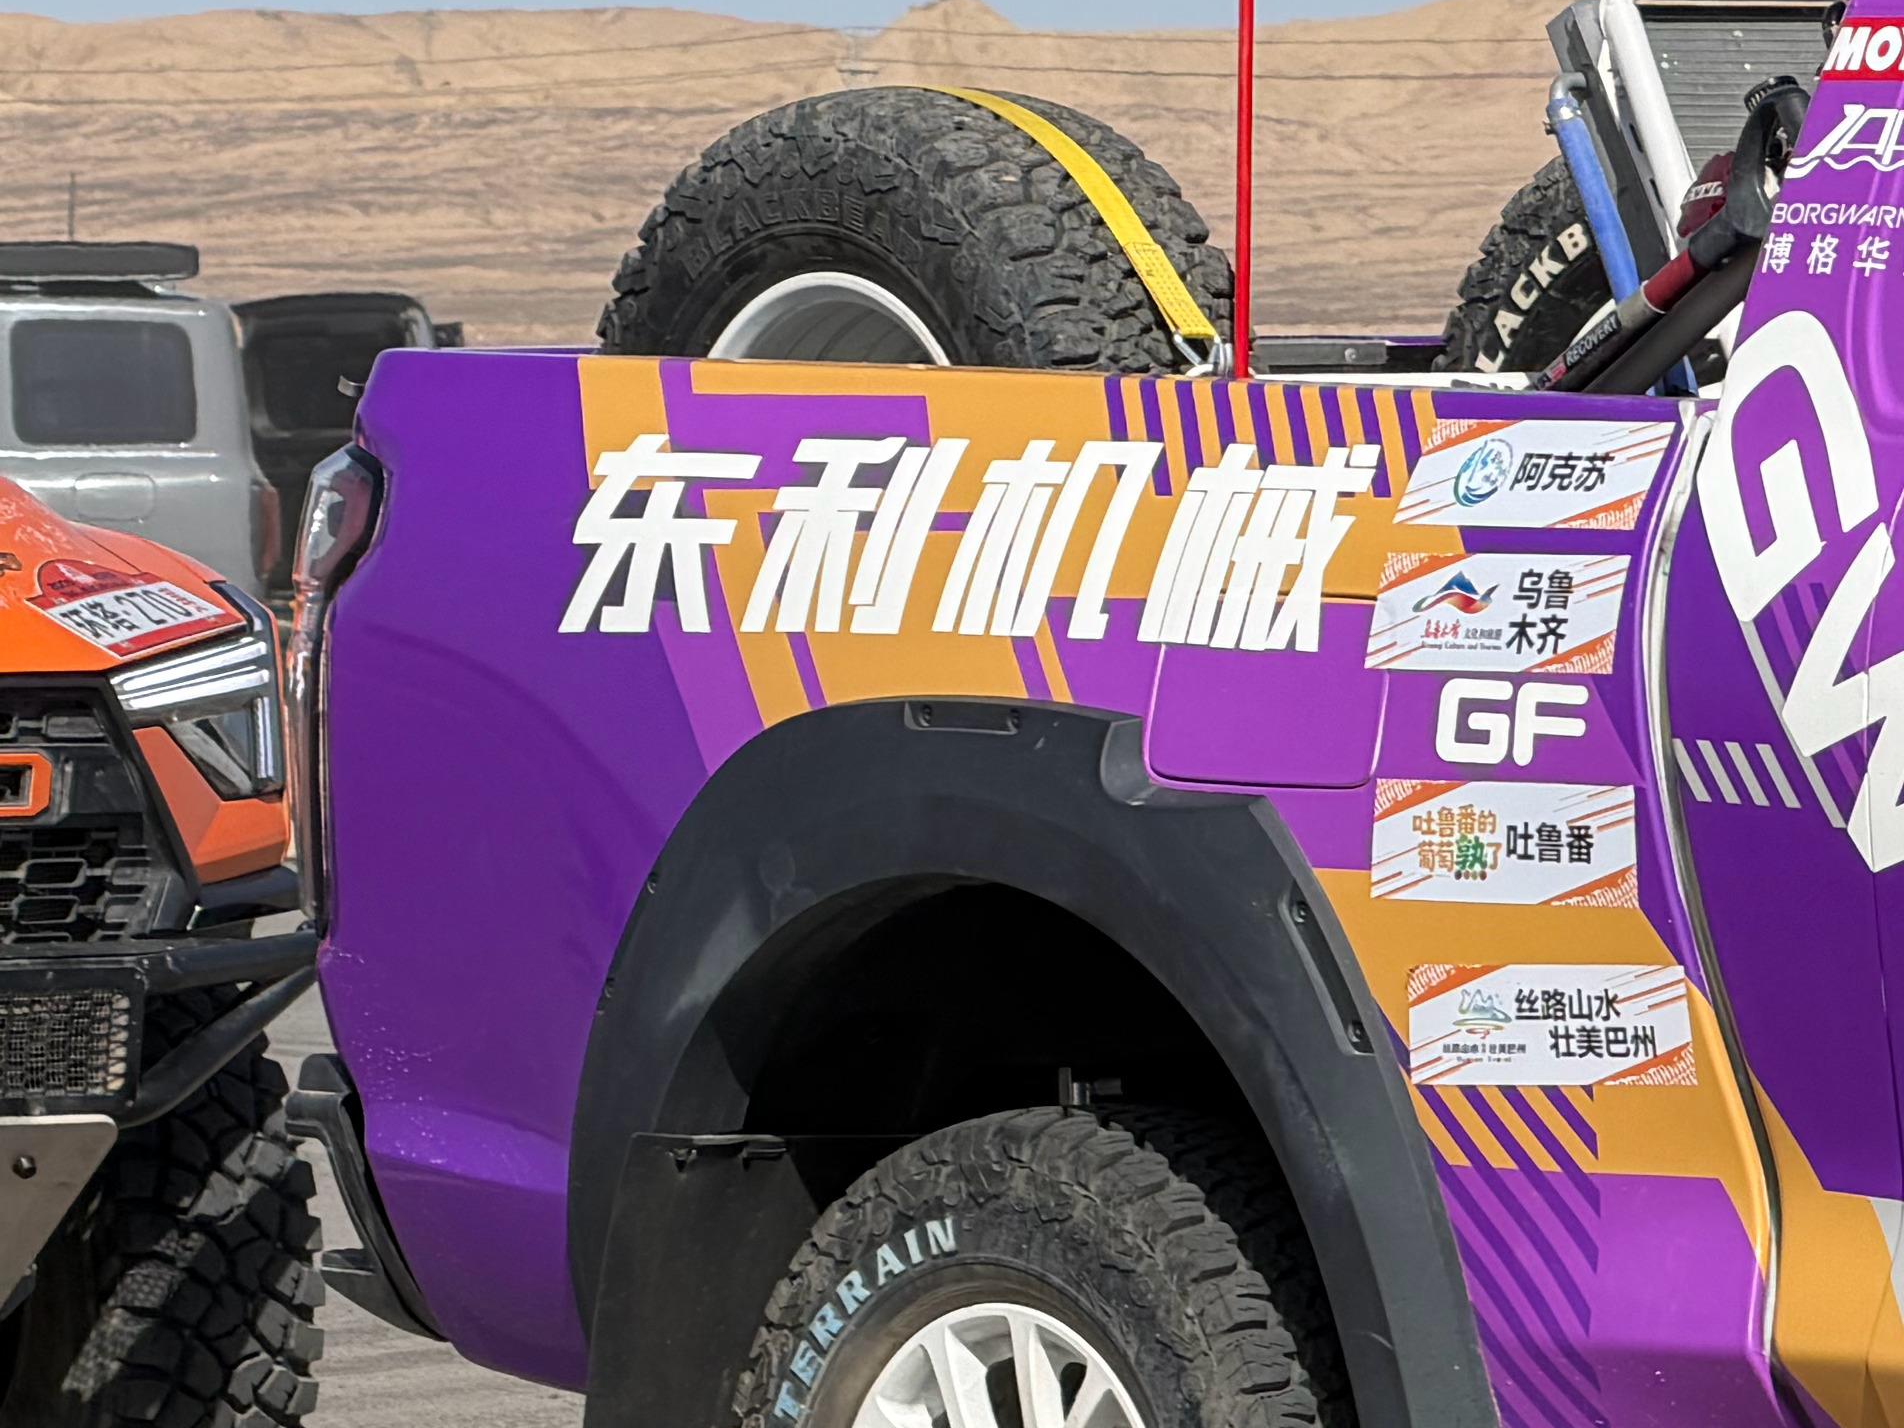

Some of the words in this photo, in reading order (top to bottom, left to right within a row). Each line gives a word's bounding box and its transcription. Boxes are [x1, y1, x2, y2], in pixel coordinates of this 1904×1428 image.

[1510, 452, 1616, 492] 阿克苏
[557, 433, 1381, 653] 东利机械
[1435, 677, 1590, 766] GF
[1507, 821, 1595, 865] 吐鲁番
[1514, 988, 1621, 1023] 丝路山水
[1549, 1025, 1657, 1060] 壮美巴州
[773, 1217, 958, 1418] TERRAIN
